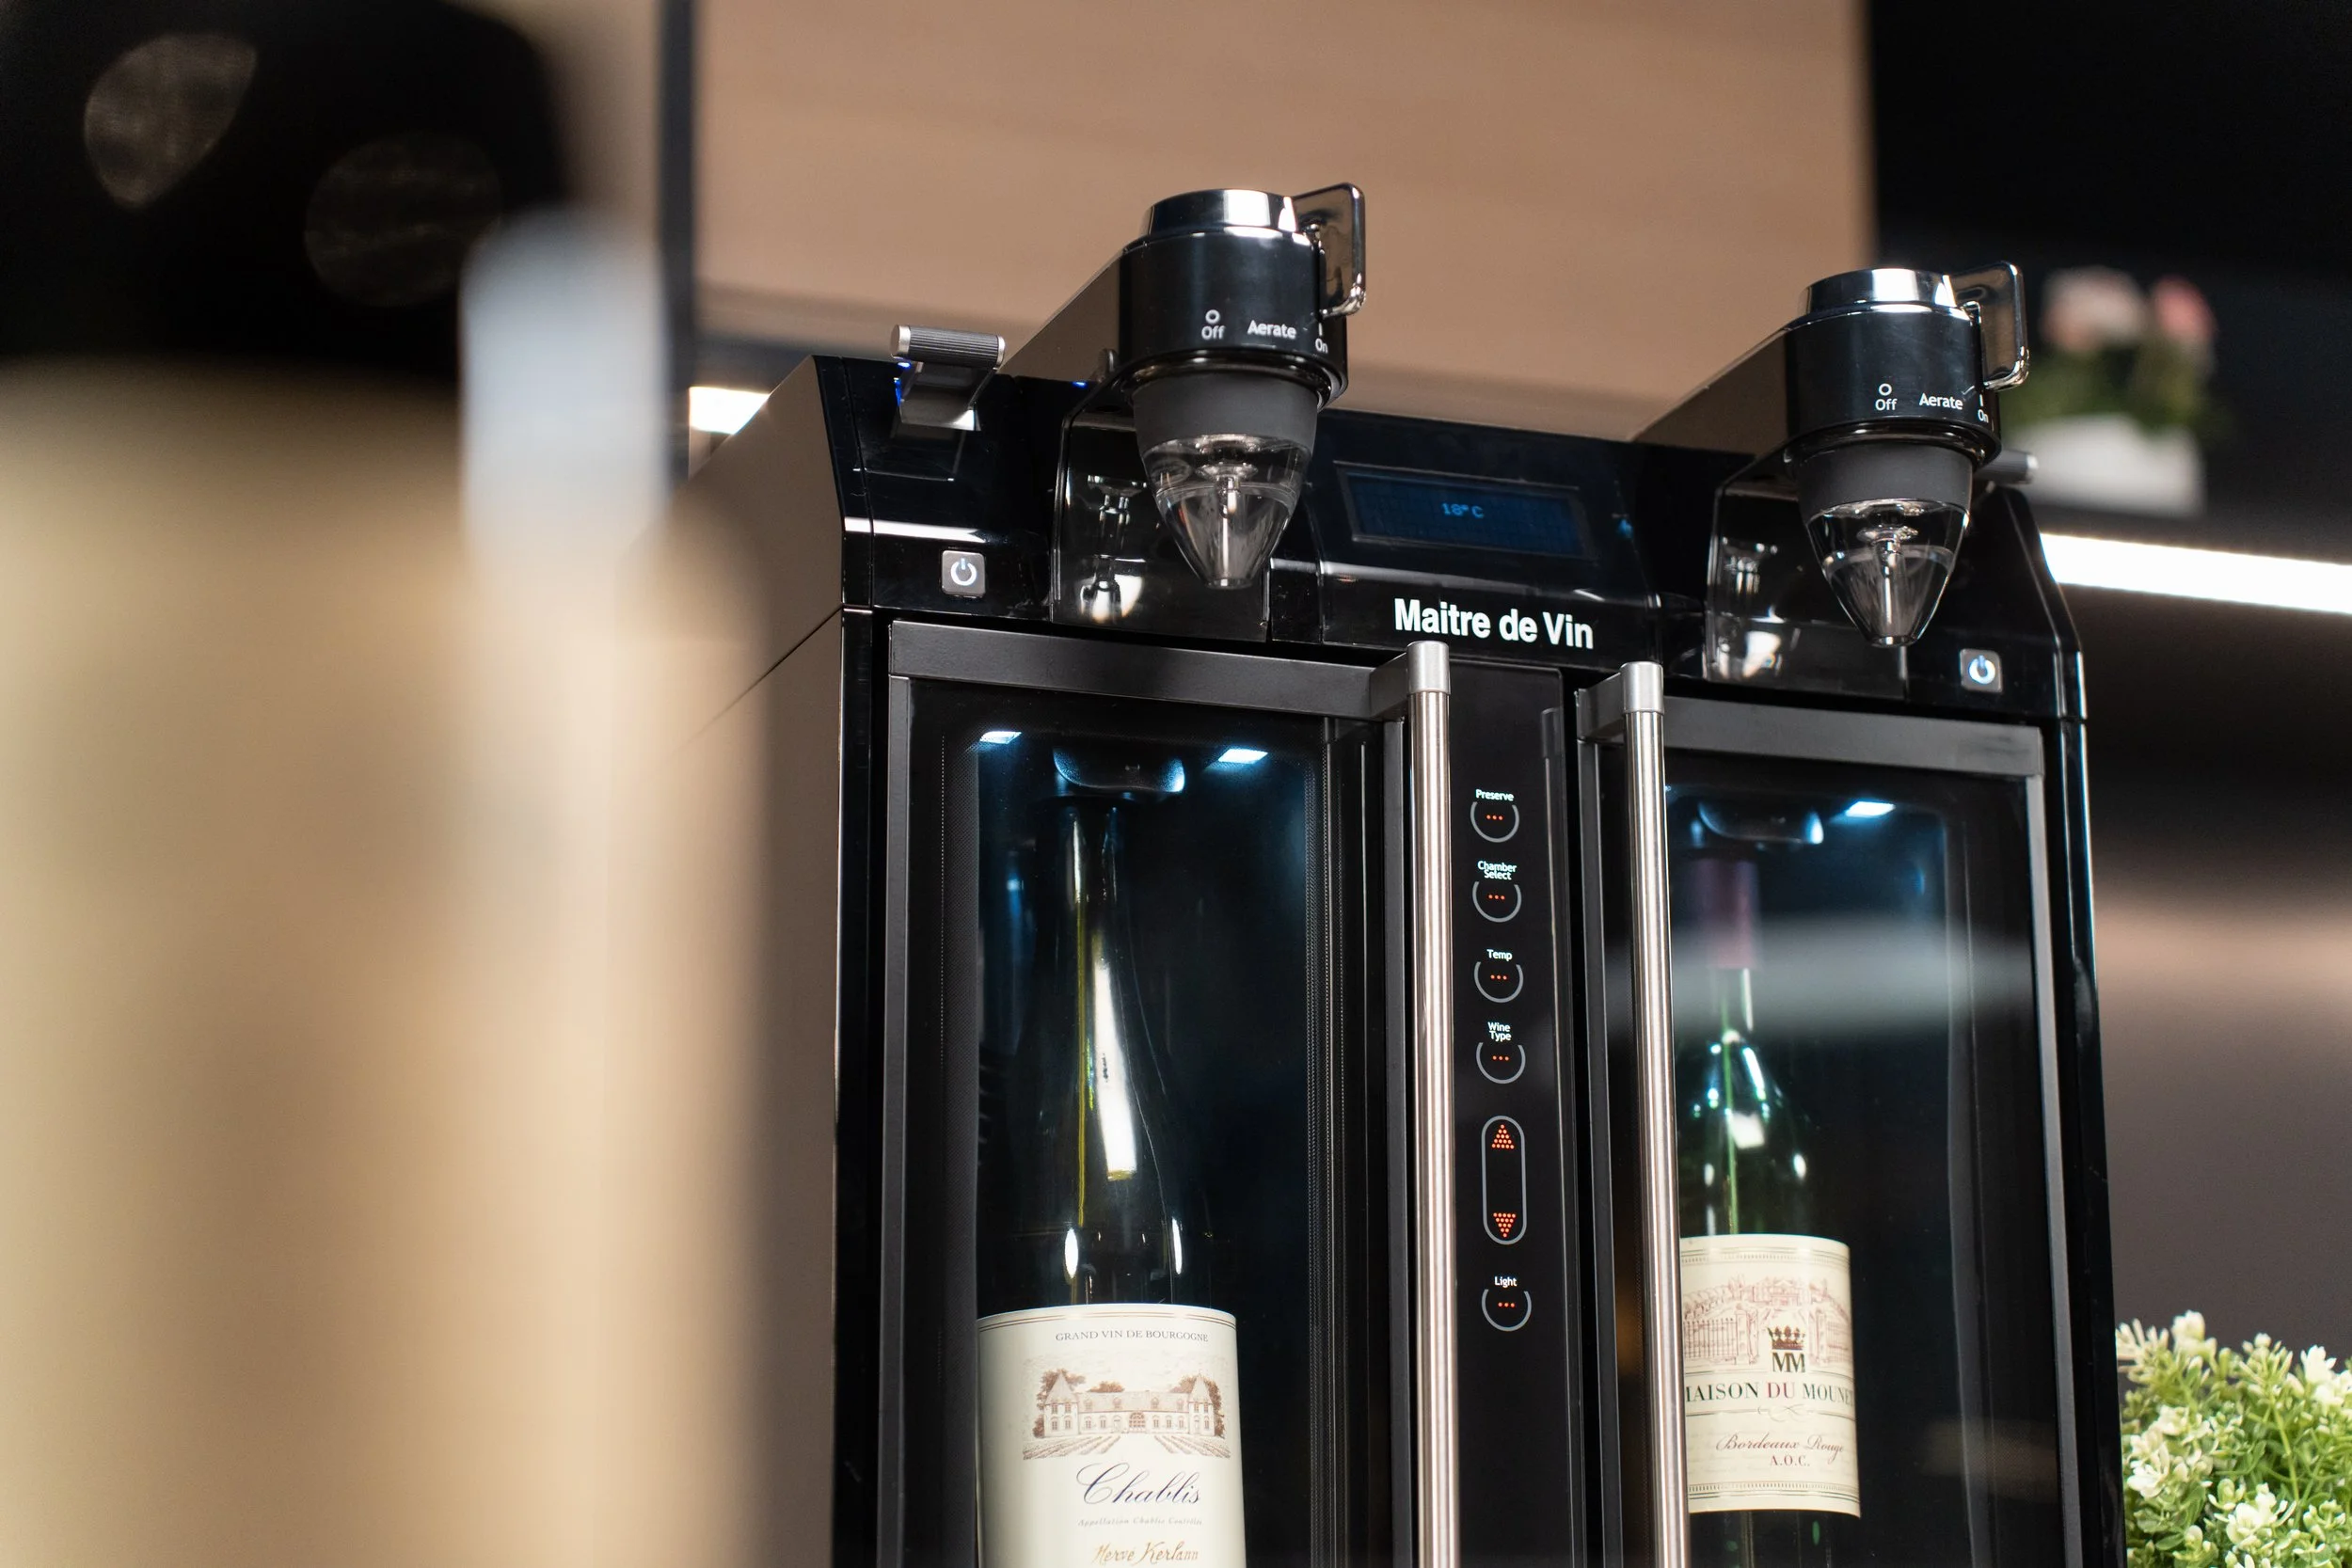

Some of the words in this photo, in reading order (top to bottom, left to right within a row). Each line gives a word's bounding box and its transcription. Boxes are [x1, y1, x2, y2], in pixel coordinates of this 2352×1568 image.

[1200, 325, 1226, 340] Off
[1247, 319, 1297, 340] Aerate
[1314, 338, 1328, 355] On
[1874, 398, 1898, 411] Off
[1918, 392, 1963, 411] Aerate
[1977, 408, 1990, 423] On
[1393, 597, 1491, 639] Maitre
[1498, 609, 1538, 643] de
[1542, 611, 1594, 650] Vin
[1475, 788, 1515, 801] Preserve
[1477, 861, 1517, 873] Chamber
[1484, 868, 1512, 880] Select
[1486, 948, 1513, 961] Temp
[1487, 1022, 1511, 1033] Wine
[1489, 1030, 1511, 1042] Type
[1494, 1275, 1518, 1288] Light
[1055, 1330, 1099, 1341] GRAND
[1102, 1329, 1123, 1338] VIN
[1126, 1329, 1143, 1338] DE
[1145, 1330, 1209, 1343] BOURGOGNE
[1767, 1382, 1795, 1400] DU
[1715, 1432, 1801, 1450] Bordeaux
[1803, 1434, 1845, 1465] Rouge
[1770, 1454, 1811, 1467] A.O.C.
[1075, 1462, 1200, 1505] Chablis
